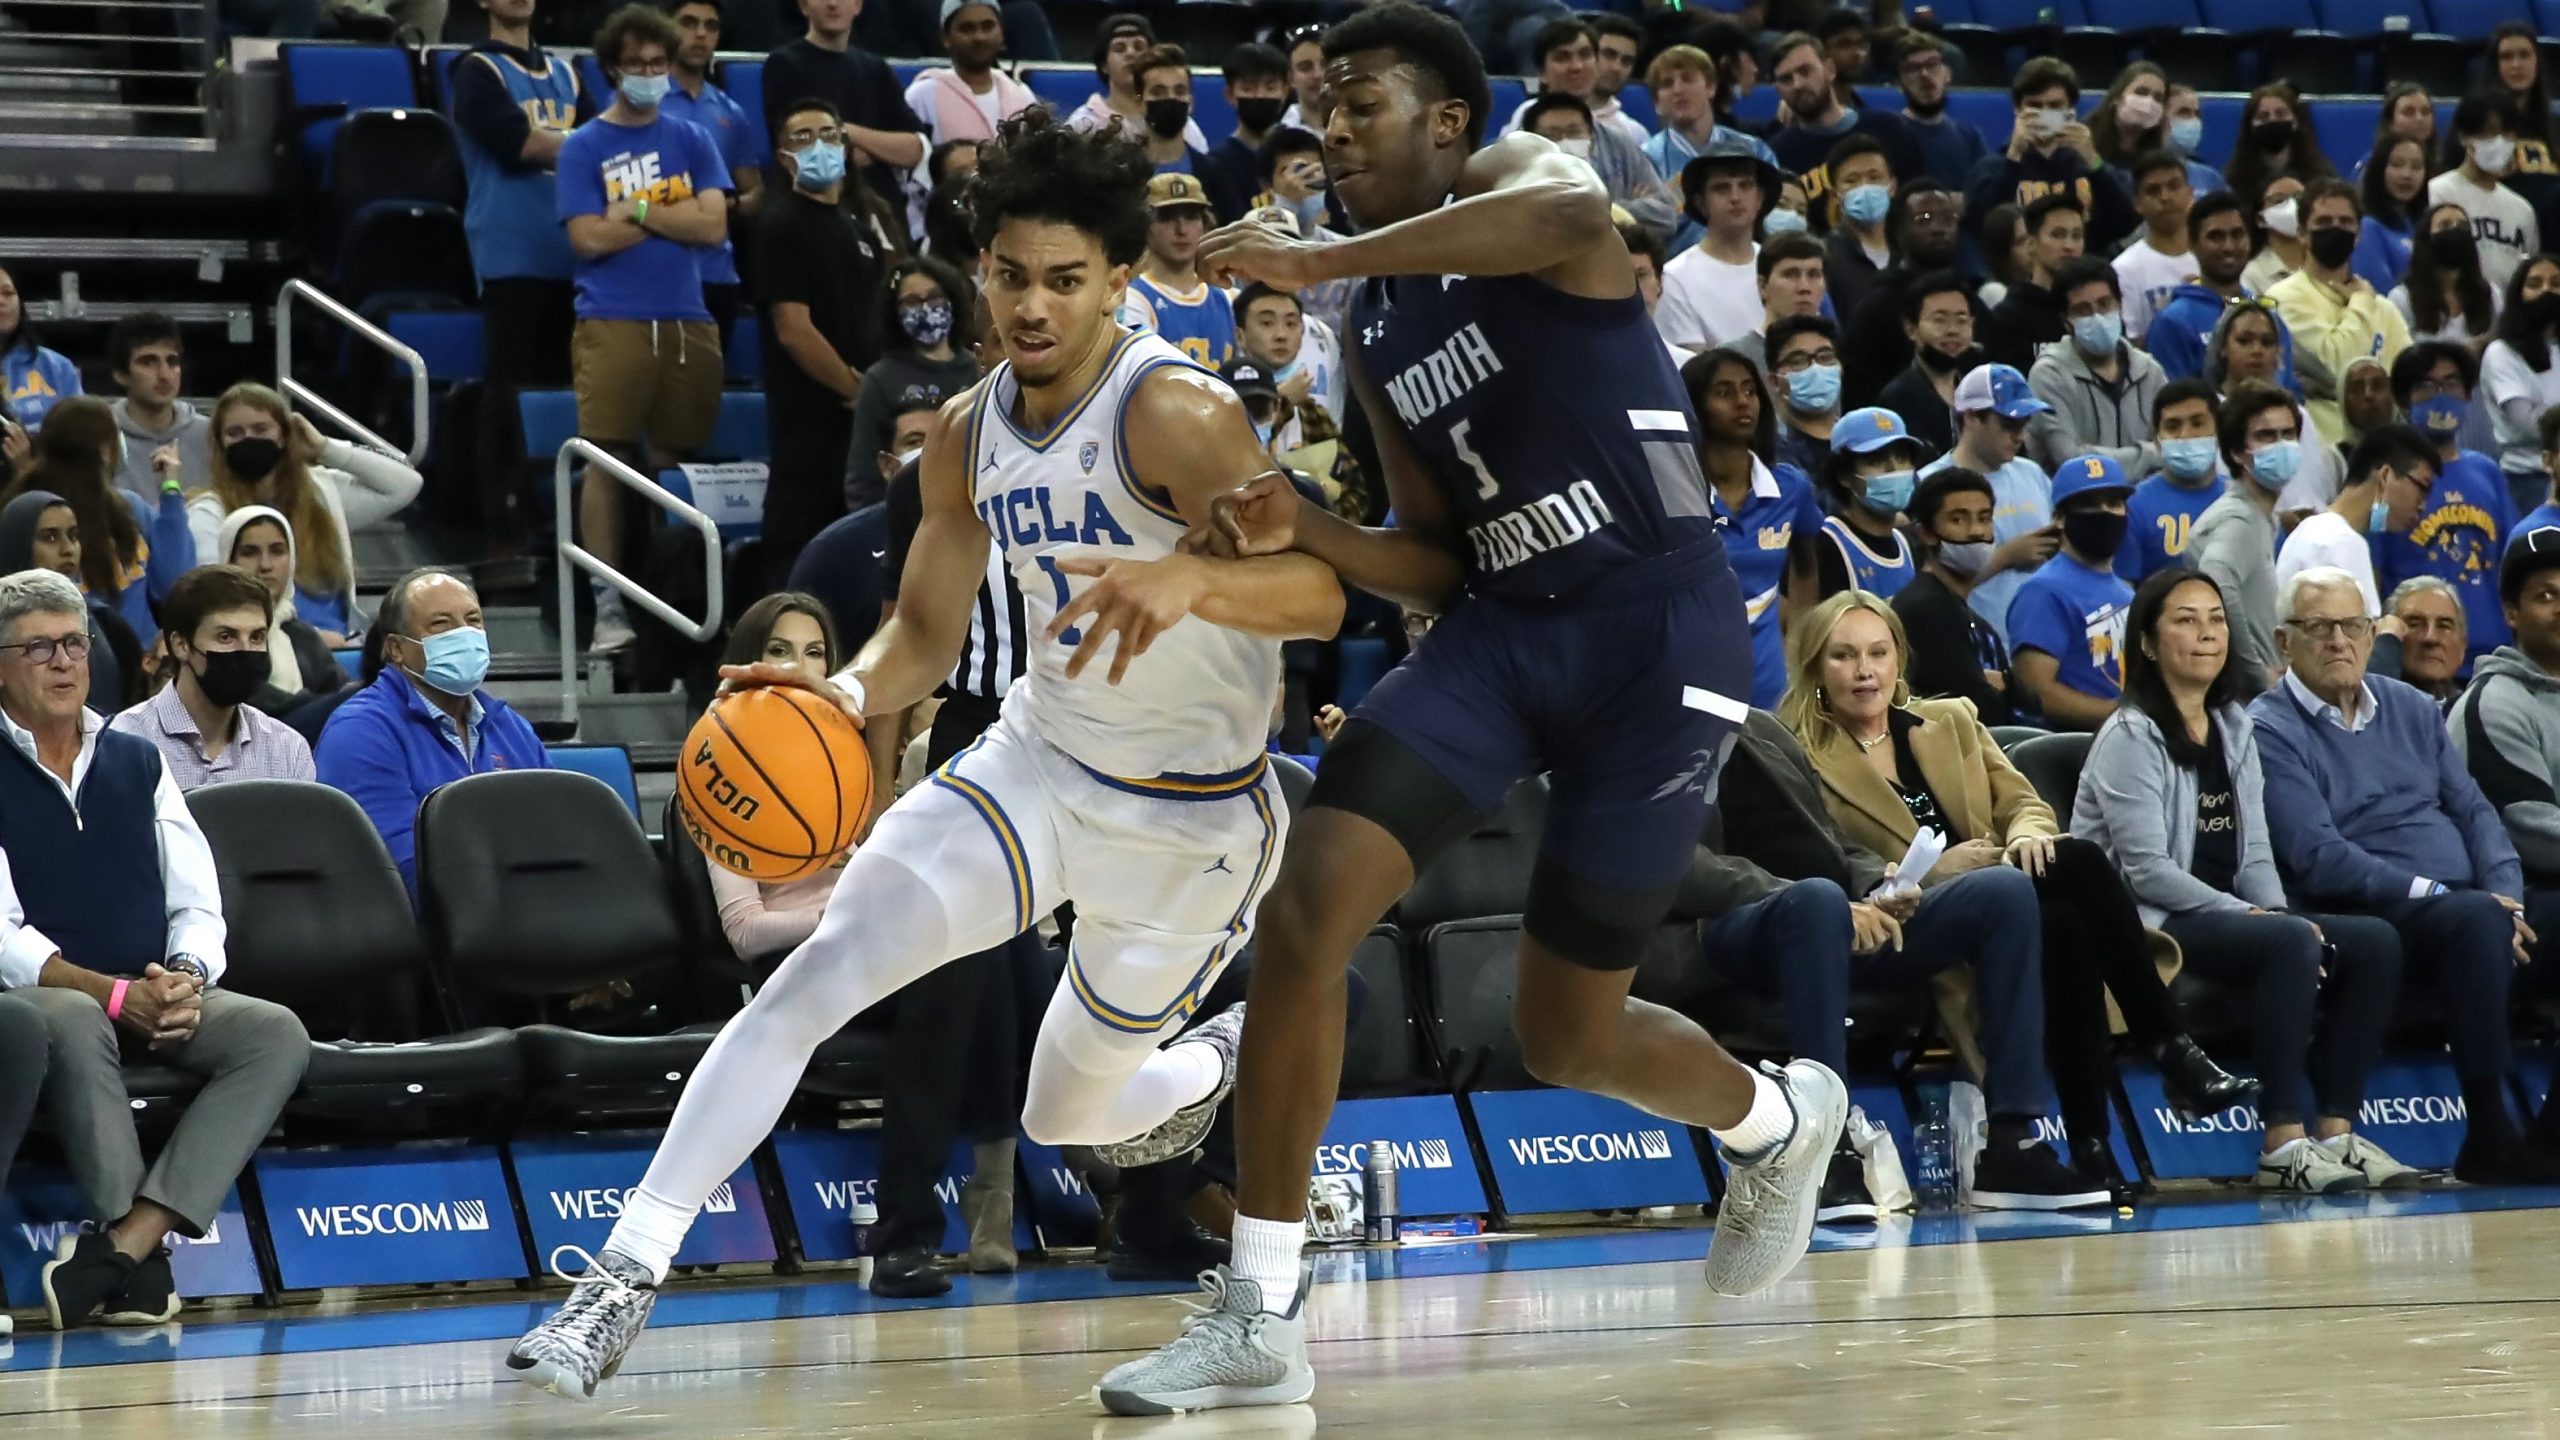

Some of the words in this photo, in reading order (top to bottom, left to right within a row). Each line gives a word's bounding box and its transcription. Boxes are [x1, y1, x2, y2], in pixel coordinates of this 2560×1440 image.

[604, 152, 663, 201] THE
[1385, 322, 1504, 430] NORTH
[1449, 416, 1499, 501] 5
[2084, 459, 2105, 479] B
[978, 487, 1135, 552] UCLA
[1466, 480, 1615, 573] FLORIDA
[694, 737, 760, 822] UCLA
[2359, 1096, 2467, 1126] WESCOM
[1315, 1140, 1421, 1174] ESCM
[1508, 1132, 1641, 1166] WESCOM
[1918, 1166, 1953, 1181] DASAN
[296, 1202, 453, 1237] WESCOM
